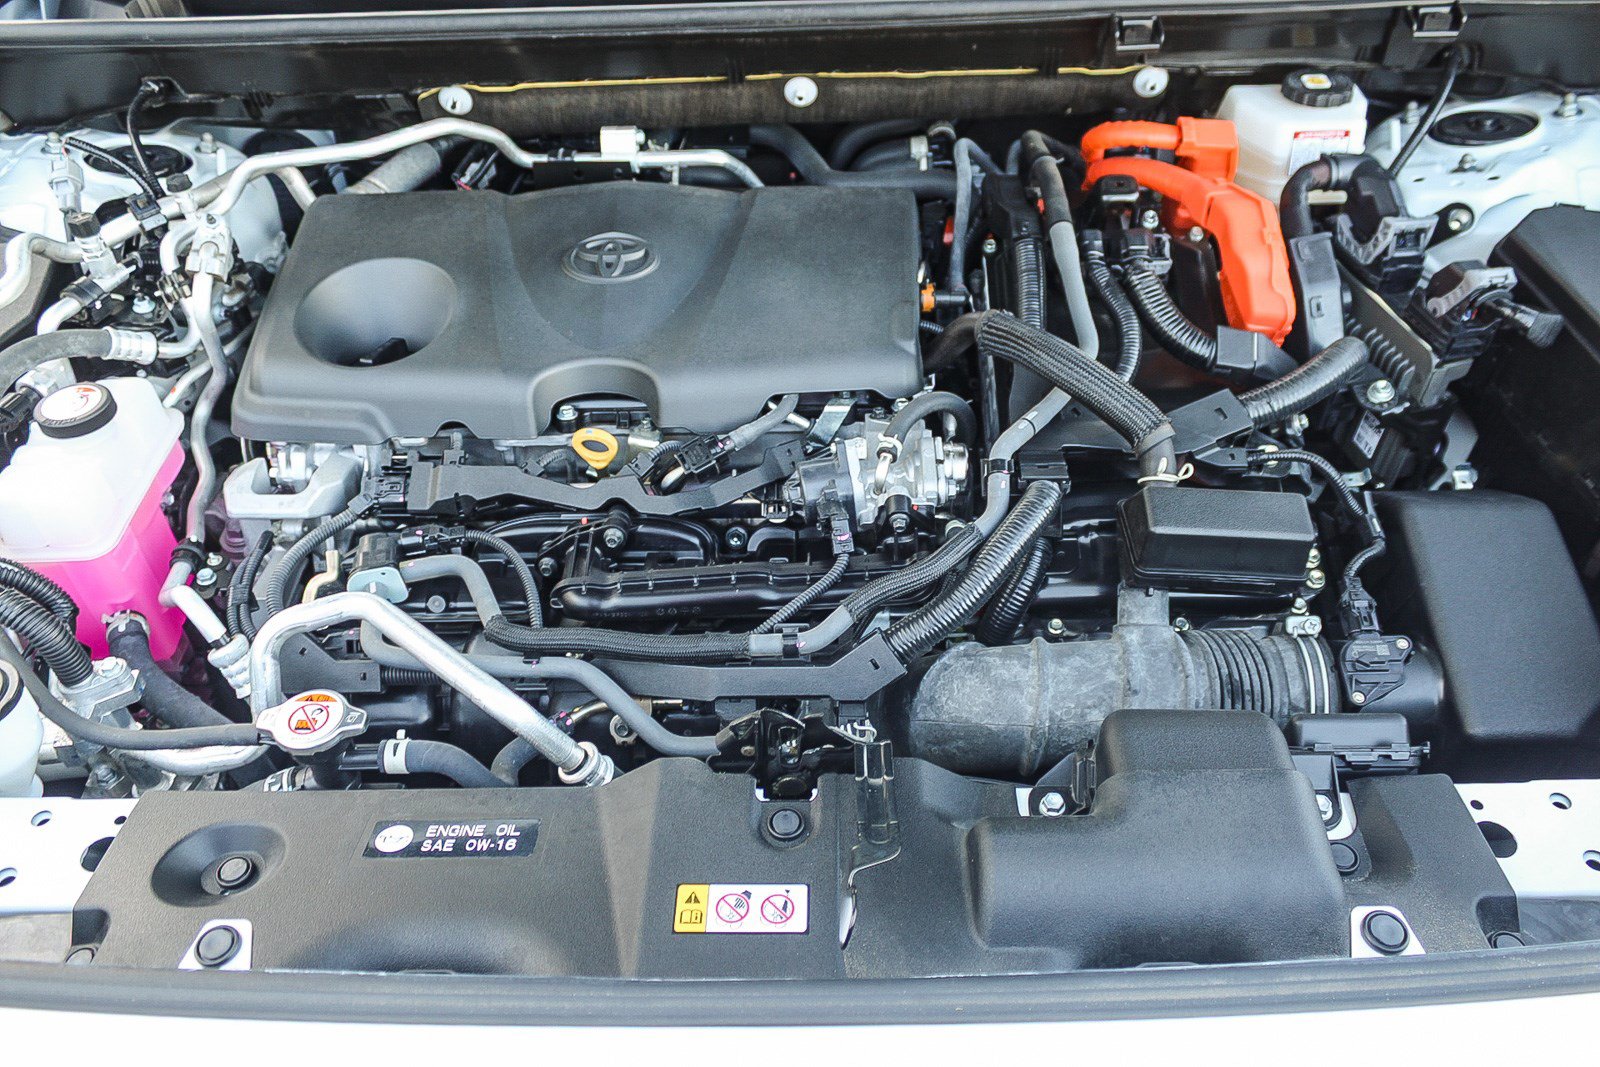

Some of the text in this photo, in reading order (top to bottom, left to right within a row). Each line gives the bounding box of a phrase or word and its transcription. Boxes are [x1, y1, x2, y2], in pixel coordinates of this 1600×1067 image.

[425, 823, 521, 838] ENGINE OIL
[420, 838, 456, 852] SAE
